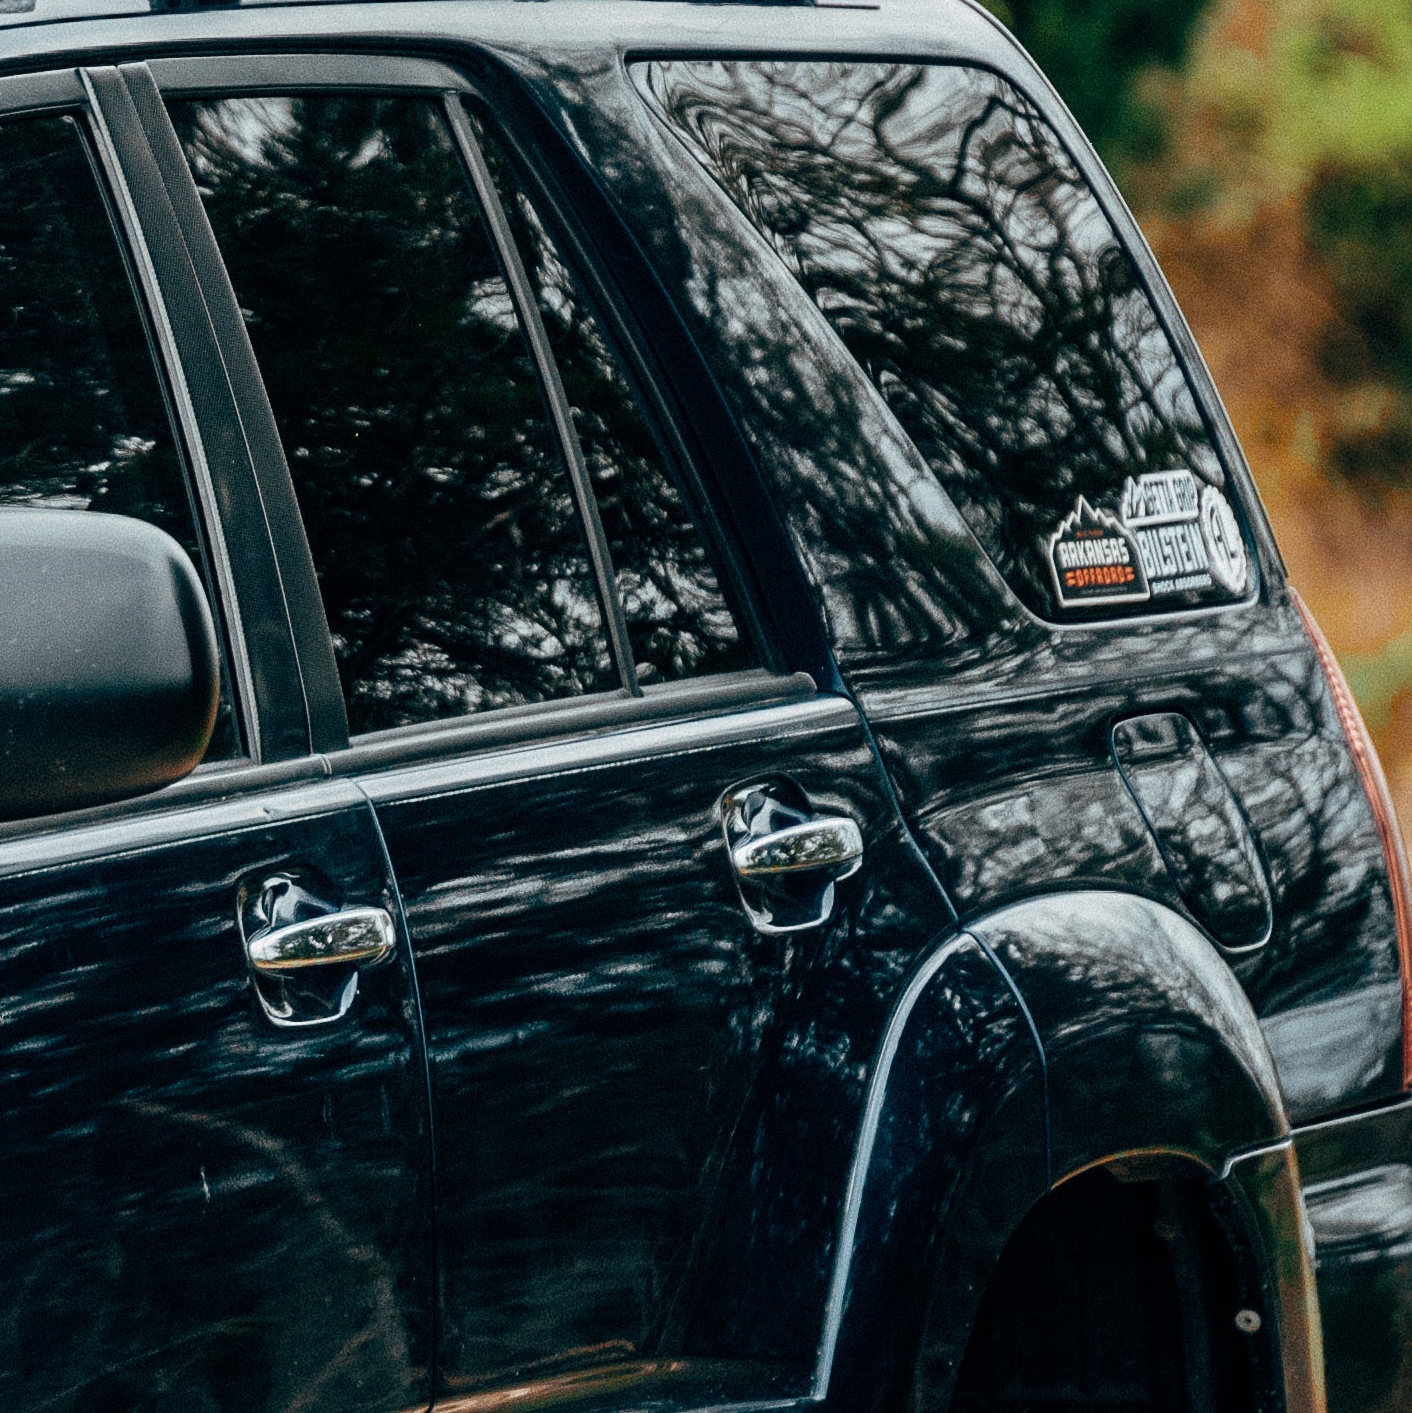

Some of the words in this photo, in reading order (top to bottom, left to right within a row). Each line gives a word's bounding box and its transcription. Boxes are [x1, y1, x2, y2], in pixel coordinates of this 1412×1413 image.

[1058, 537, 1130, 569] ARKANSAS
[1136, 522, 1210, 579] BILSTEIN
[1075, 565, 1126, 588] OFFROAD
